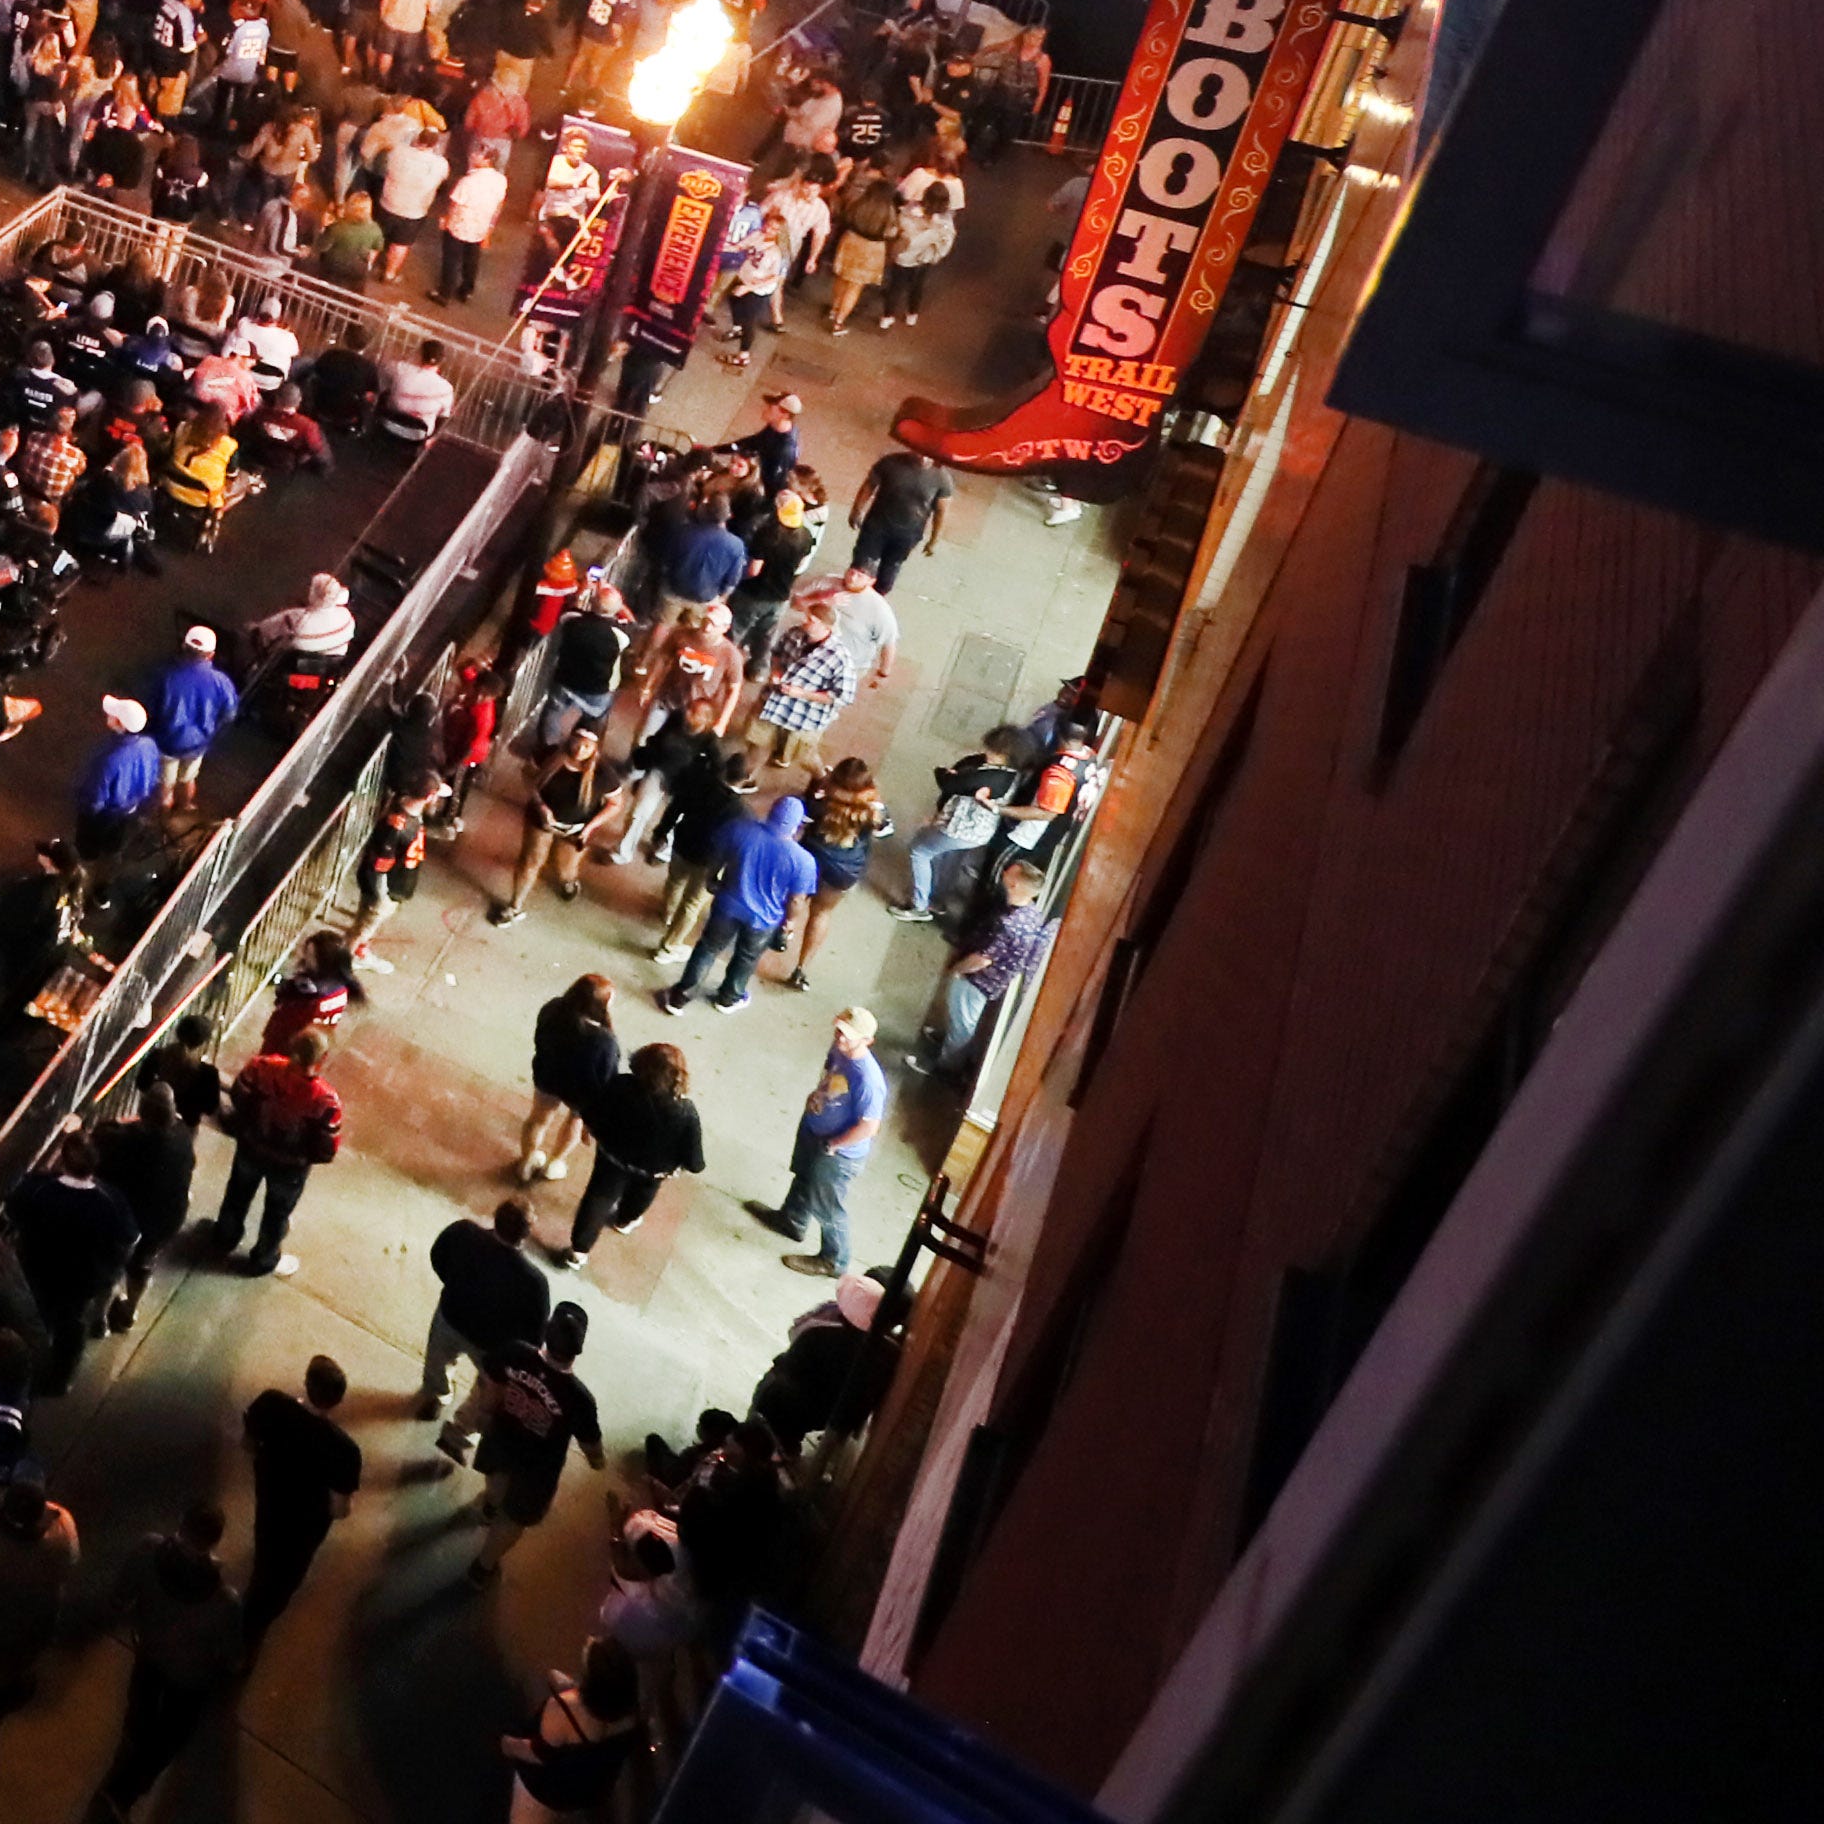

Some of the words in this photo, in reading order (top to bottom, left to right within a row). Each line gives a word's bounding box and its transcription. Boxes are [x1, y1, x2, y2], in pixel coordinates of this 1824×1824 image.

[852, 123, 883, 145] 25
[578, 236, 603, 259] 25
[654, 198, 708, 304] EXPERIENCE
[568, 265, 593, 287] 27
[1062, 354, 1178, 396] TRAIL
[1059, 379, 1162, 430] WEST
[1036, 437, 1094, 463] TW
